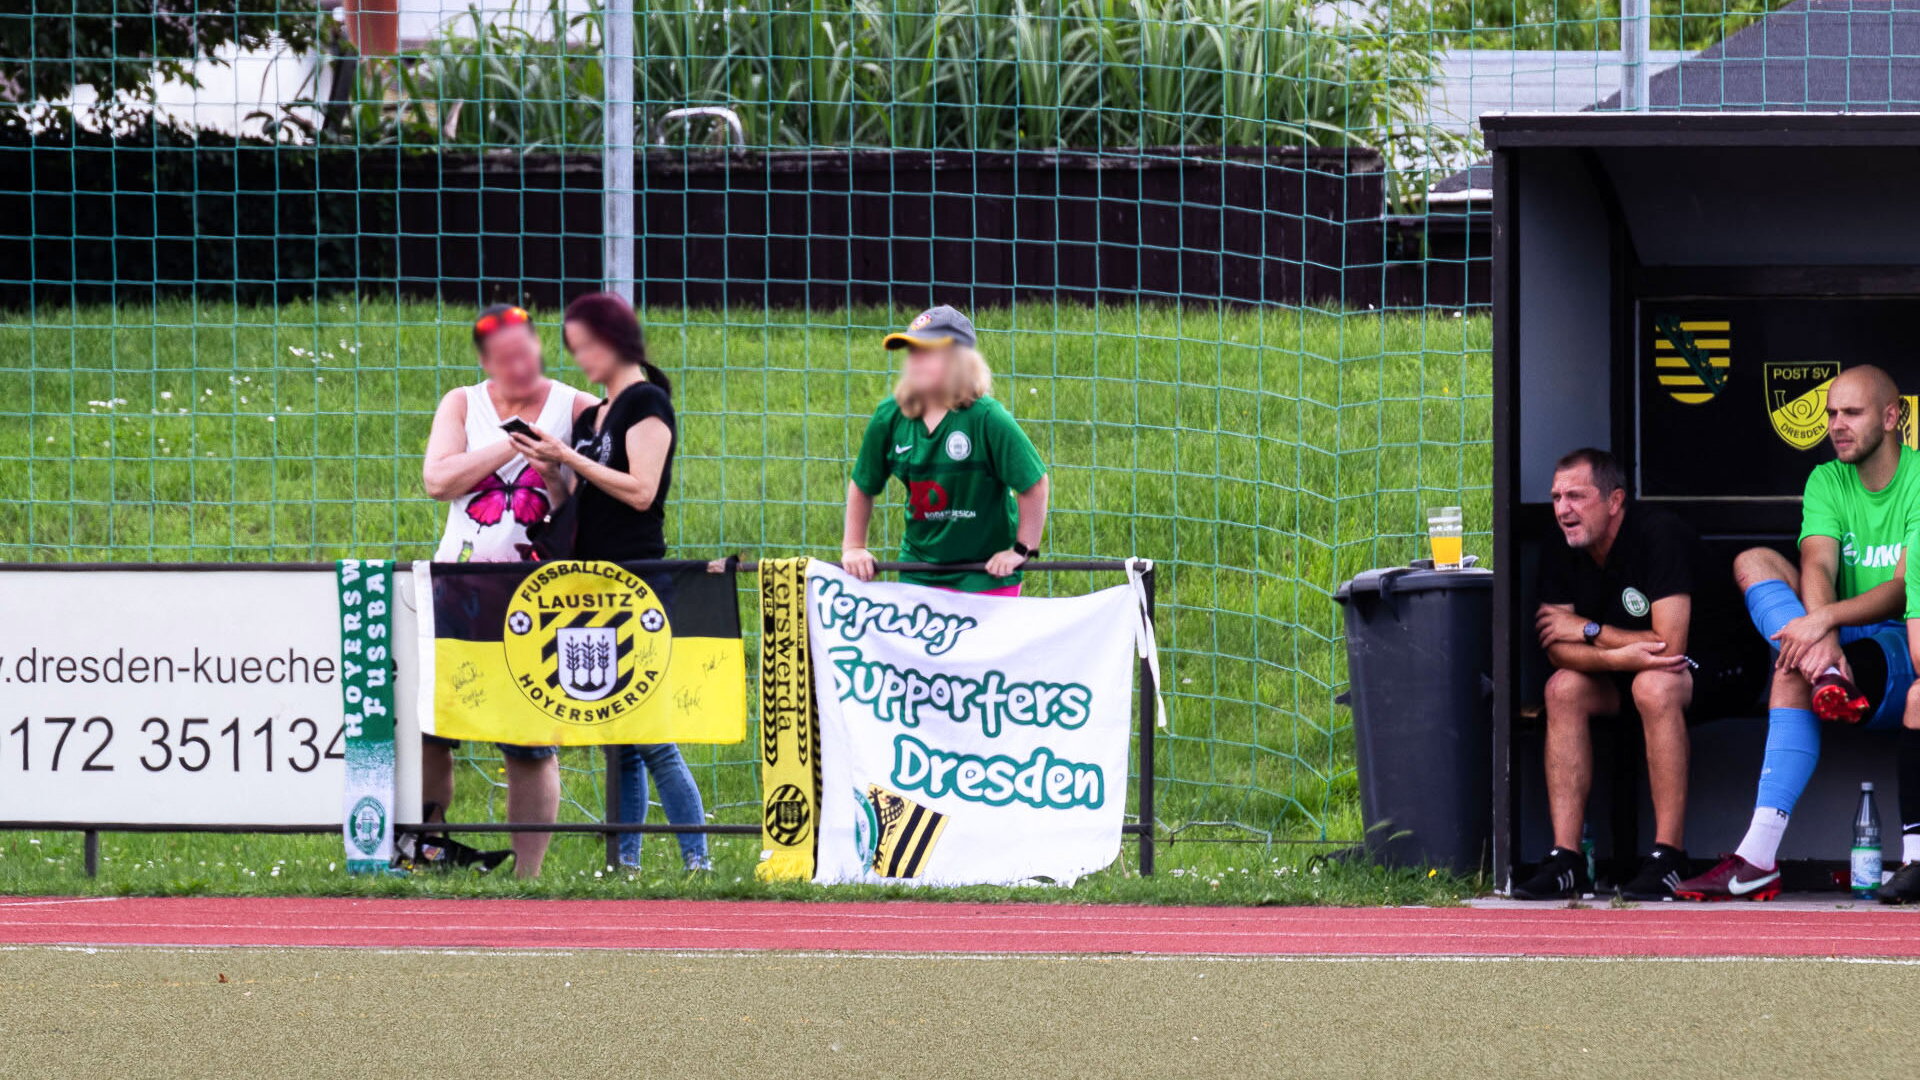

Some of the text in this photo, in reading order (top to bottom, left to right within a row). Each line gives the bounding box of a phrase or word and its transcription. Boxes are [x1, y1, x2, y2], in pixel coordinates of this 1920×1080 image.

[1773, 367, 1830, 380] POST SV
[1780, 422, 1825, 439] DRESDEN
[521, 562, 648, 602] FUSSBALLCLUB
[538, 593, 632, 609] LAUSITZ
[0, 647, 398, 684] .dresden-kueche
[519, 668, 659, 723] HOYERSWERDA
[828, 646, 1093, 738] Supporters
[0, 716, 115, 773] 172
[890, 733, 1105, 810] Dresden
